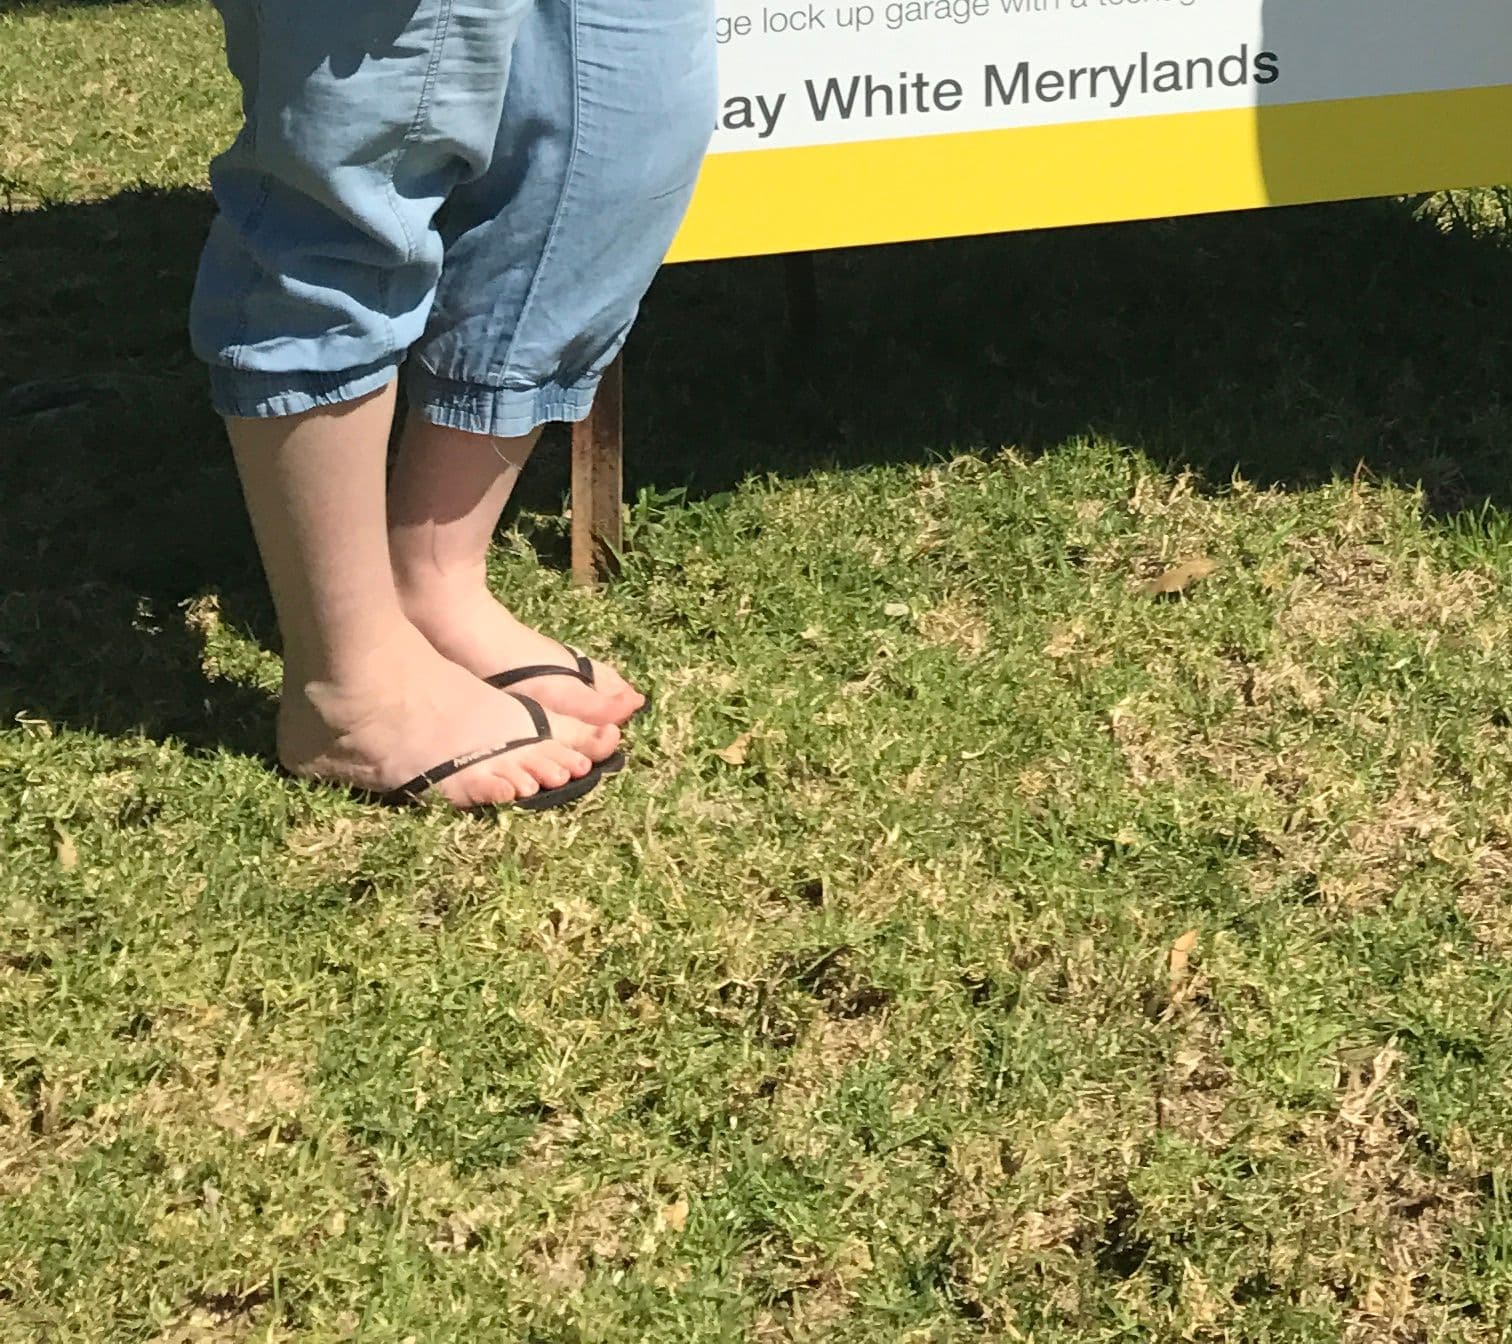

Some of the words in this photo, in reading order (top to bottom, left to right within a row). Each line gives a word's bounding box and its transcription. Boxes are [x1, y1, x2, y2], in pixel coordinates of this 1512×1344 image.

[763, 4, 825, 33] lock
[836, 5, 874, 32] up
[713, 94, 787, 138] ay
[804, 72, 963, 121] White
[983, 42, 1280, 110] Merrylands
